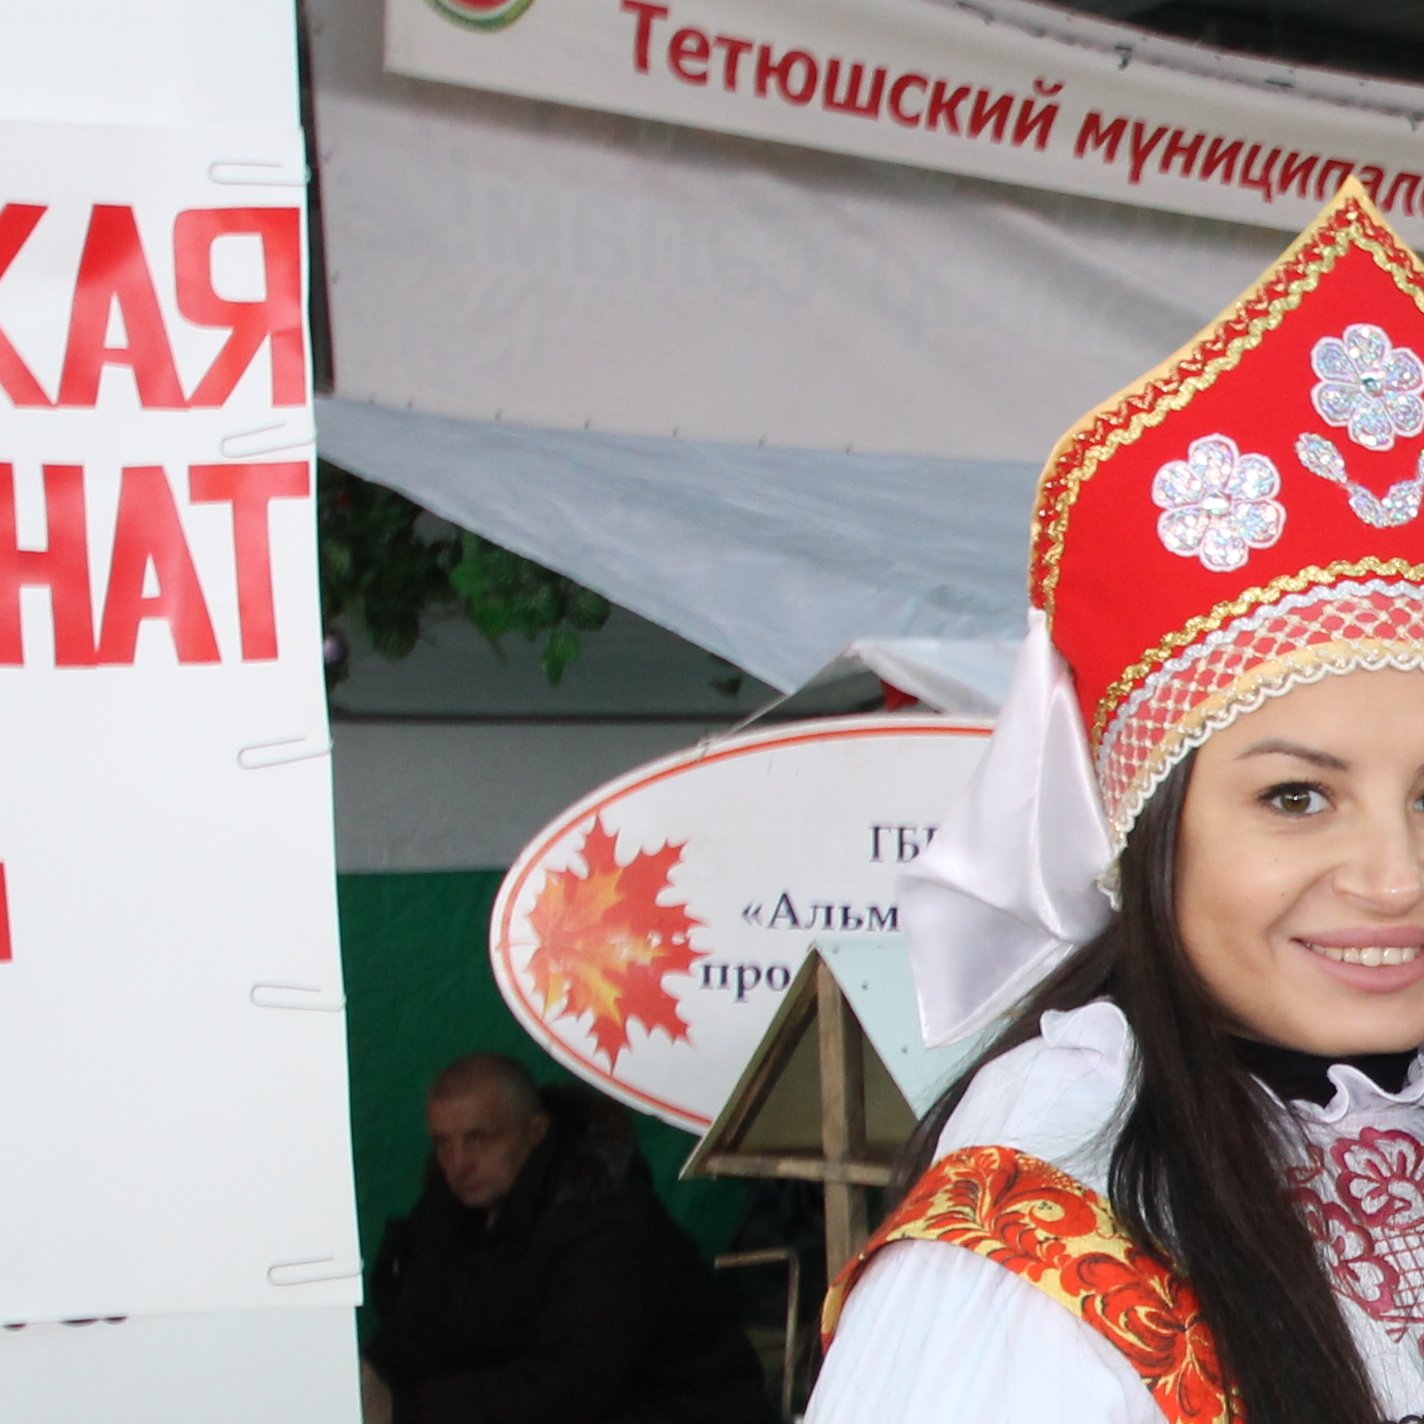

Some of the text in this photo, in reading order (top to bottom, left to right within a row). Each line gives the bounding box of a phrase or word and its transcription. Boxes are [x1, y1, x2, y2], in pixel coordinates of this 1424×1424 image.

[620, 1, 1064, 152] Тетюшский
[0, 460, 311, 668] НАТ
[701, 962, 791, 1004] про
